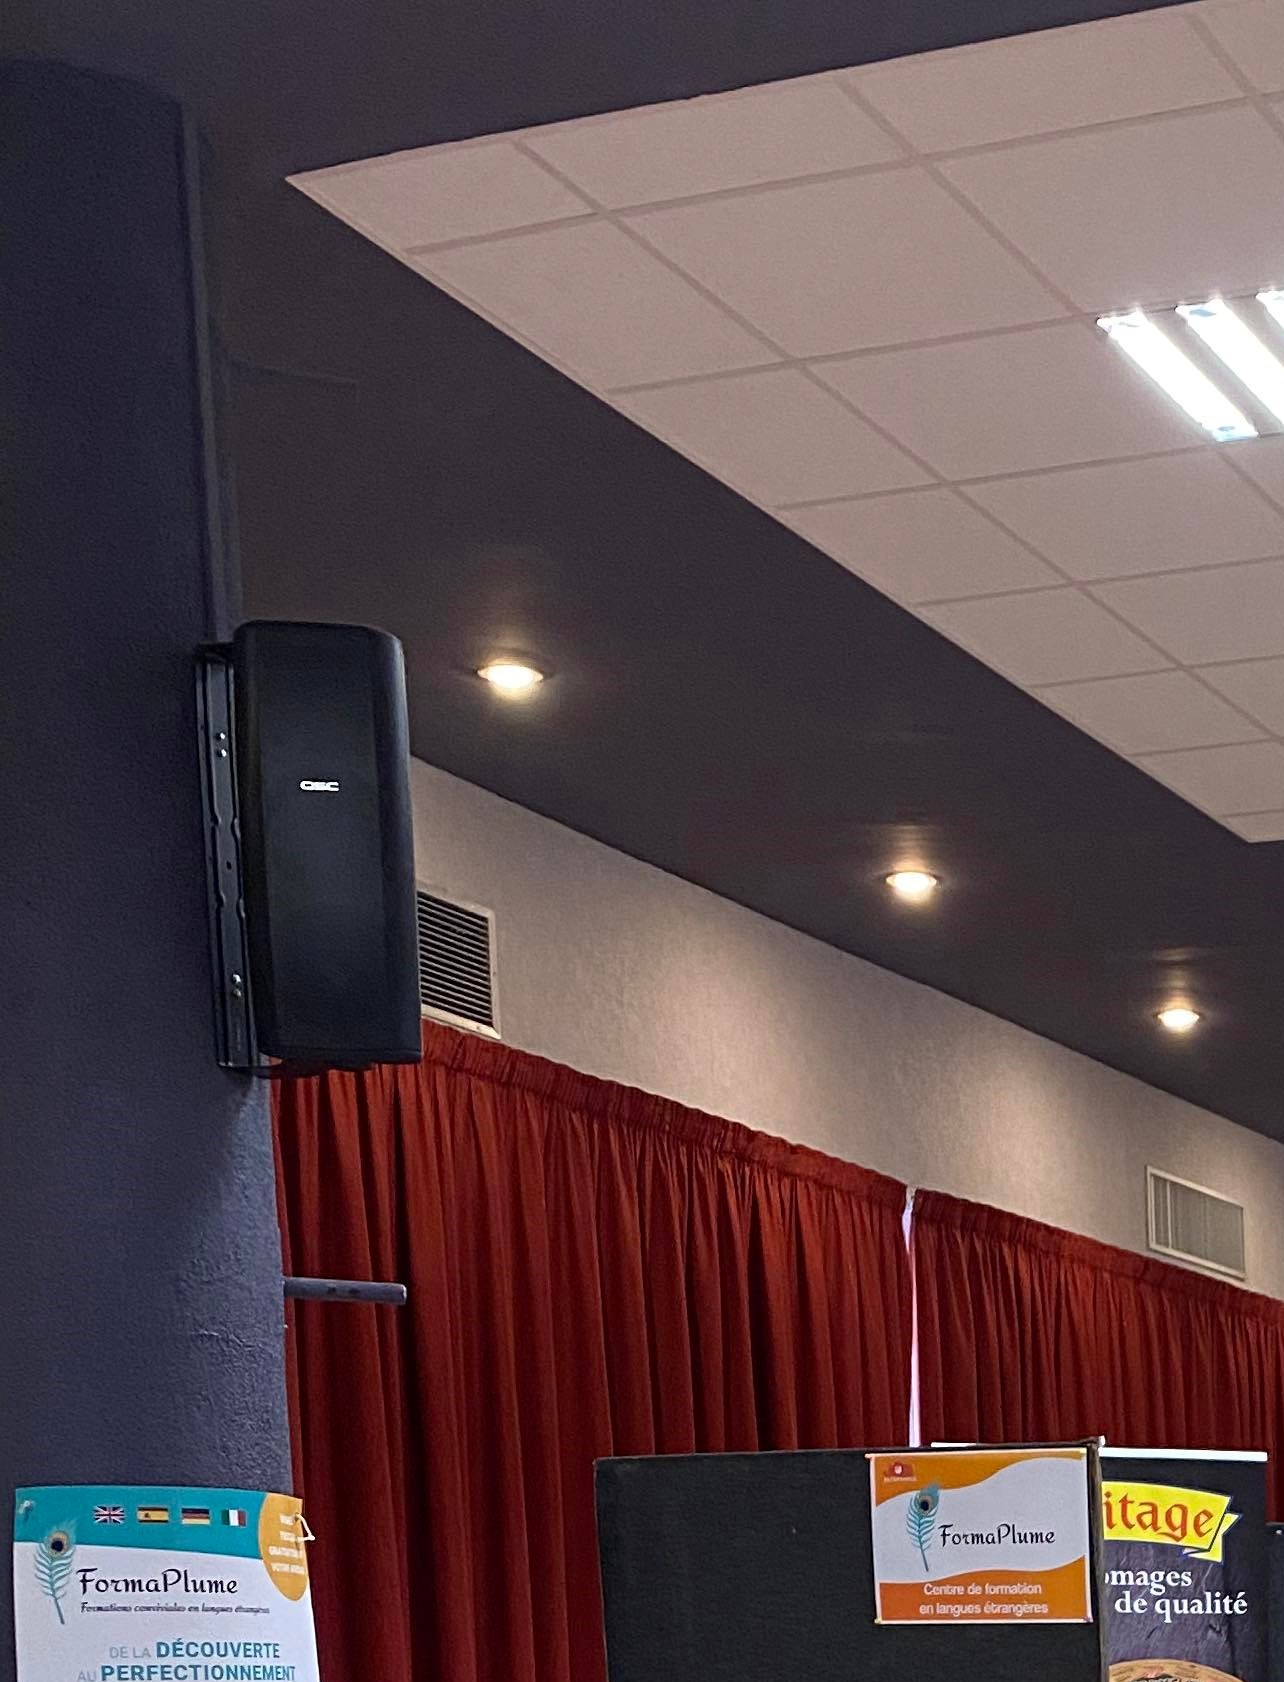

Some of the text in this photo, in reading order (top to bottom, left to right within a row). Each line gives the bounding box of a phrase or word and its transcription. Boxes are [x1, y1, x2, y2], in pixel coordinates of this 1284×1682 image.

[1103, 1491, 1214, 1543] itage
[937, 1523, 1056, 1547] FormaPlume
[76, 1567, 238, 1595] FormaPlume
[923, 1582, 1042, 1595] Centre de formation
[919, 1600, 1049, 1617] en langues étrangères
[1114, 1590, 1248, 1624] de qualité
[109, 1638, 280, 1659] DE LA DÉCOUVERTE
[77, 1664, 296, 1682] AU PERFECTIONNEMENT
